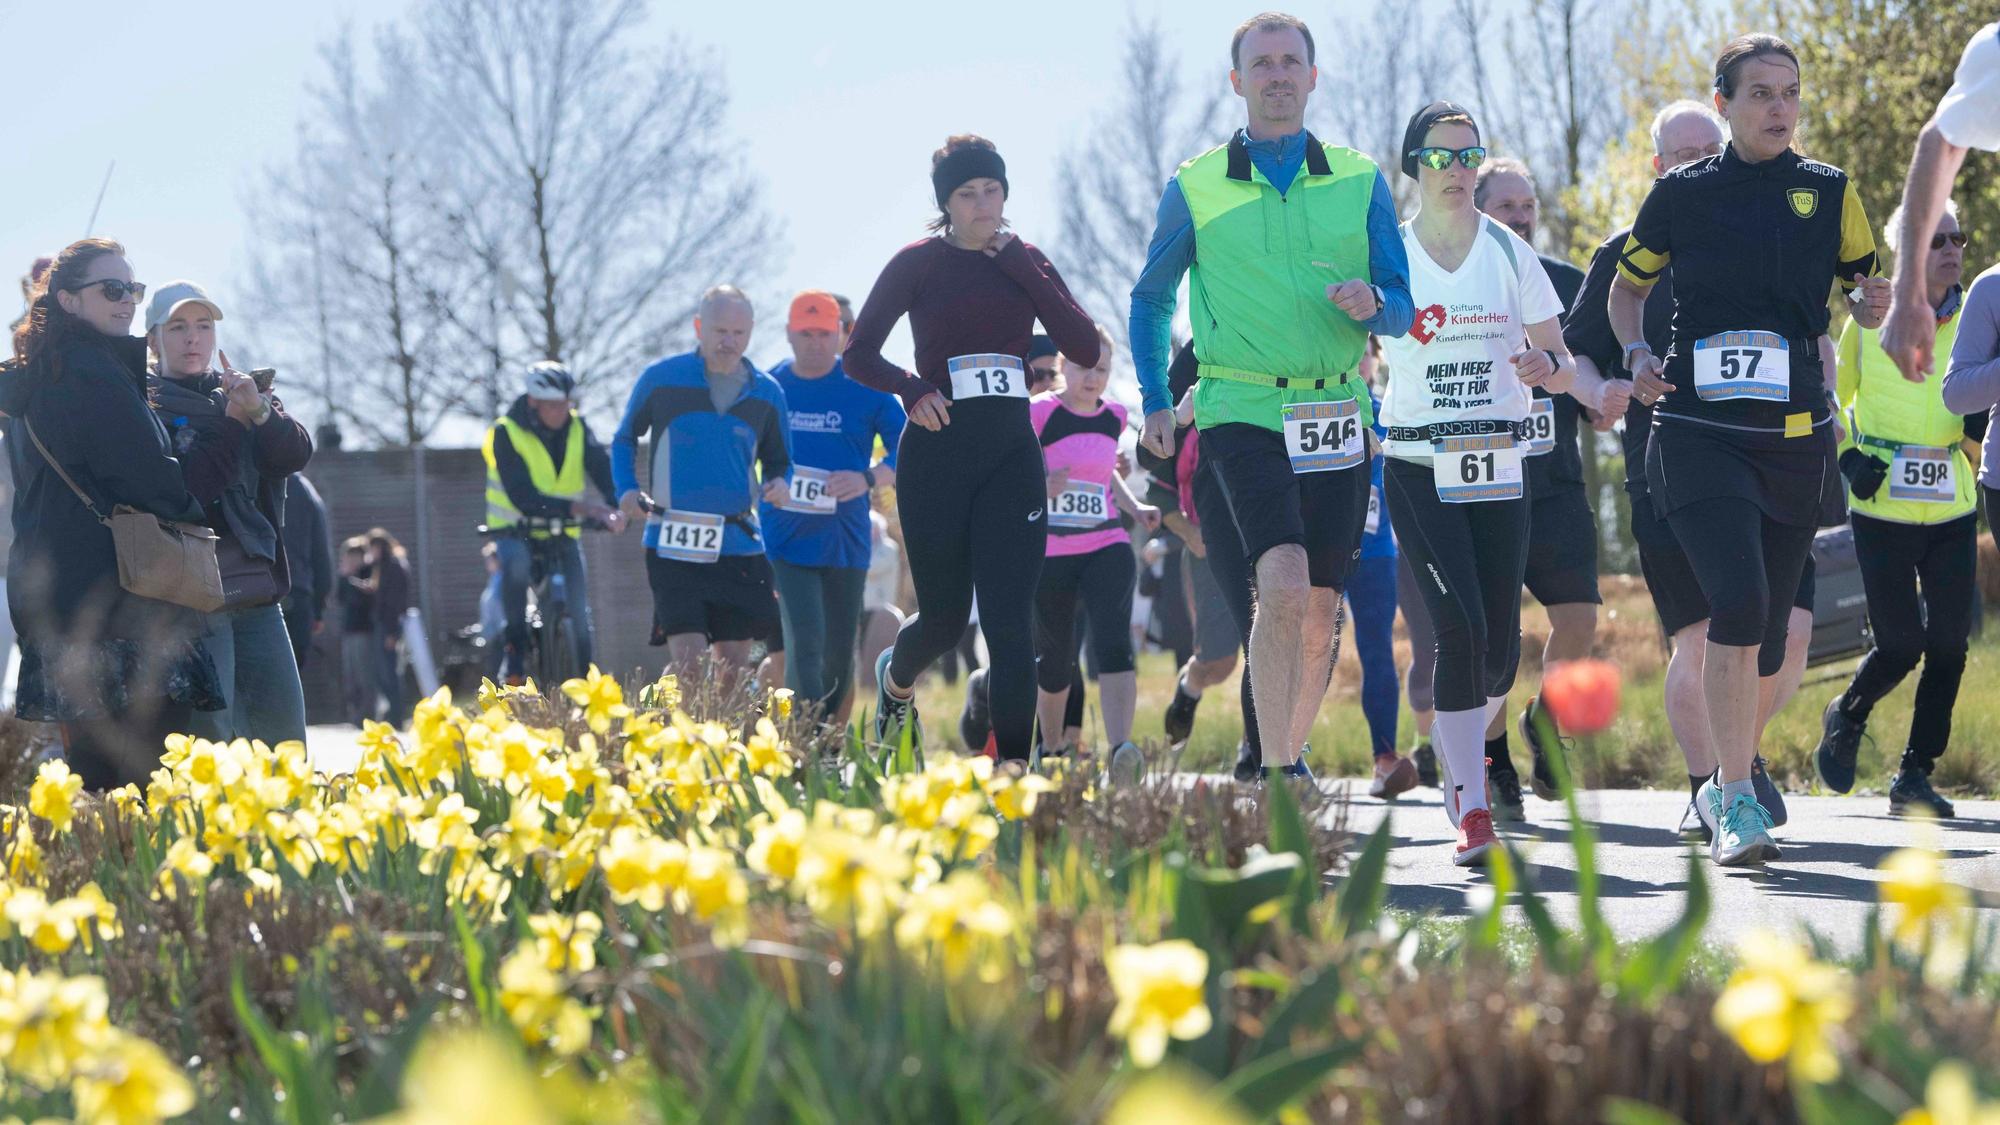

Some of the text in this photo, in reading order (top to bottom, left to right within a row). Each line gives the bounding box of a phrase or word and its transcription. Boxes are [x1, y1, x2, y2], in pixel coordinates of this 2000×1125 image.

[1796, 162, 1840, 178] FUSION
[1795, 195, 1812, 205] TuS
[1450, 303, 1484, 313] Stiftung
[1451, 312, 1509, 325] KinderHerz
[1426, 361, 1493, 380] MEIN HERZ
[1720, 349, 1763, 380] 57
[975, 369, 1010, 394] 13
[1429, 375, 1489, 396] LÄUFT FÜR
[1433, 398, 1461, 409] DEIN
[1300, 418, 1357, 453] 546
[1428, 421, 1496, 437] SUNDRIED
[1461, 452, 1495, 483] 61
[1904, 461, 1948, 487] 598
[1051, 493, 1102, 515] 1388
[665, 523, 717, 549] 1412
